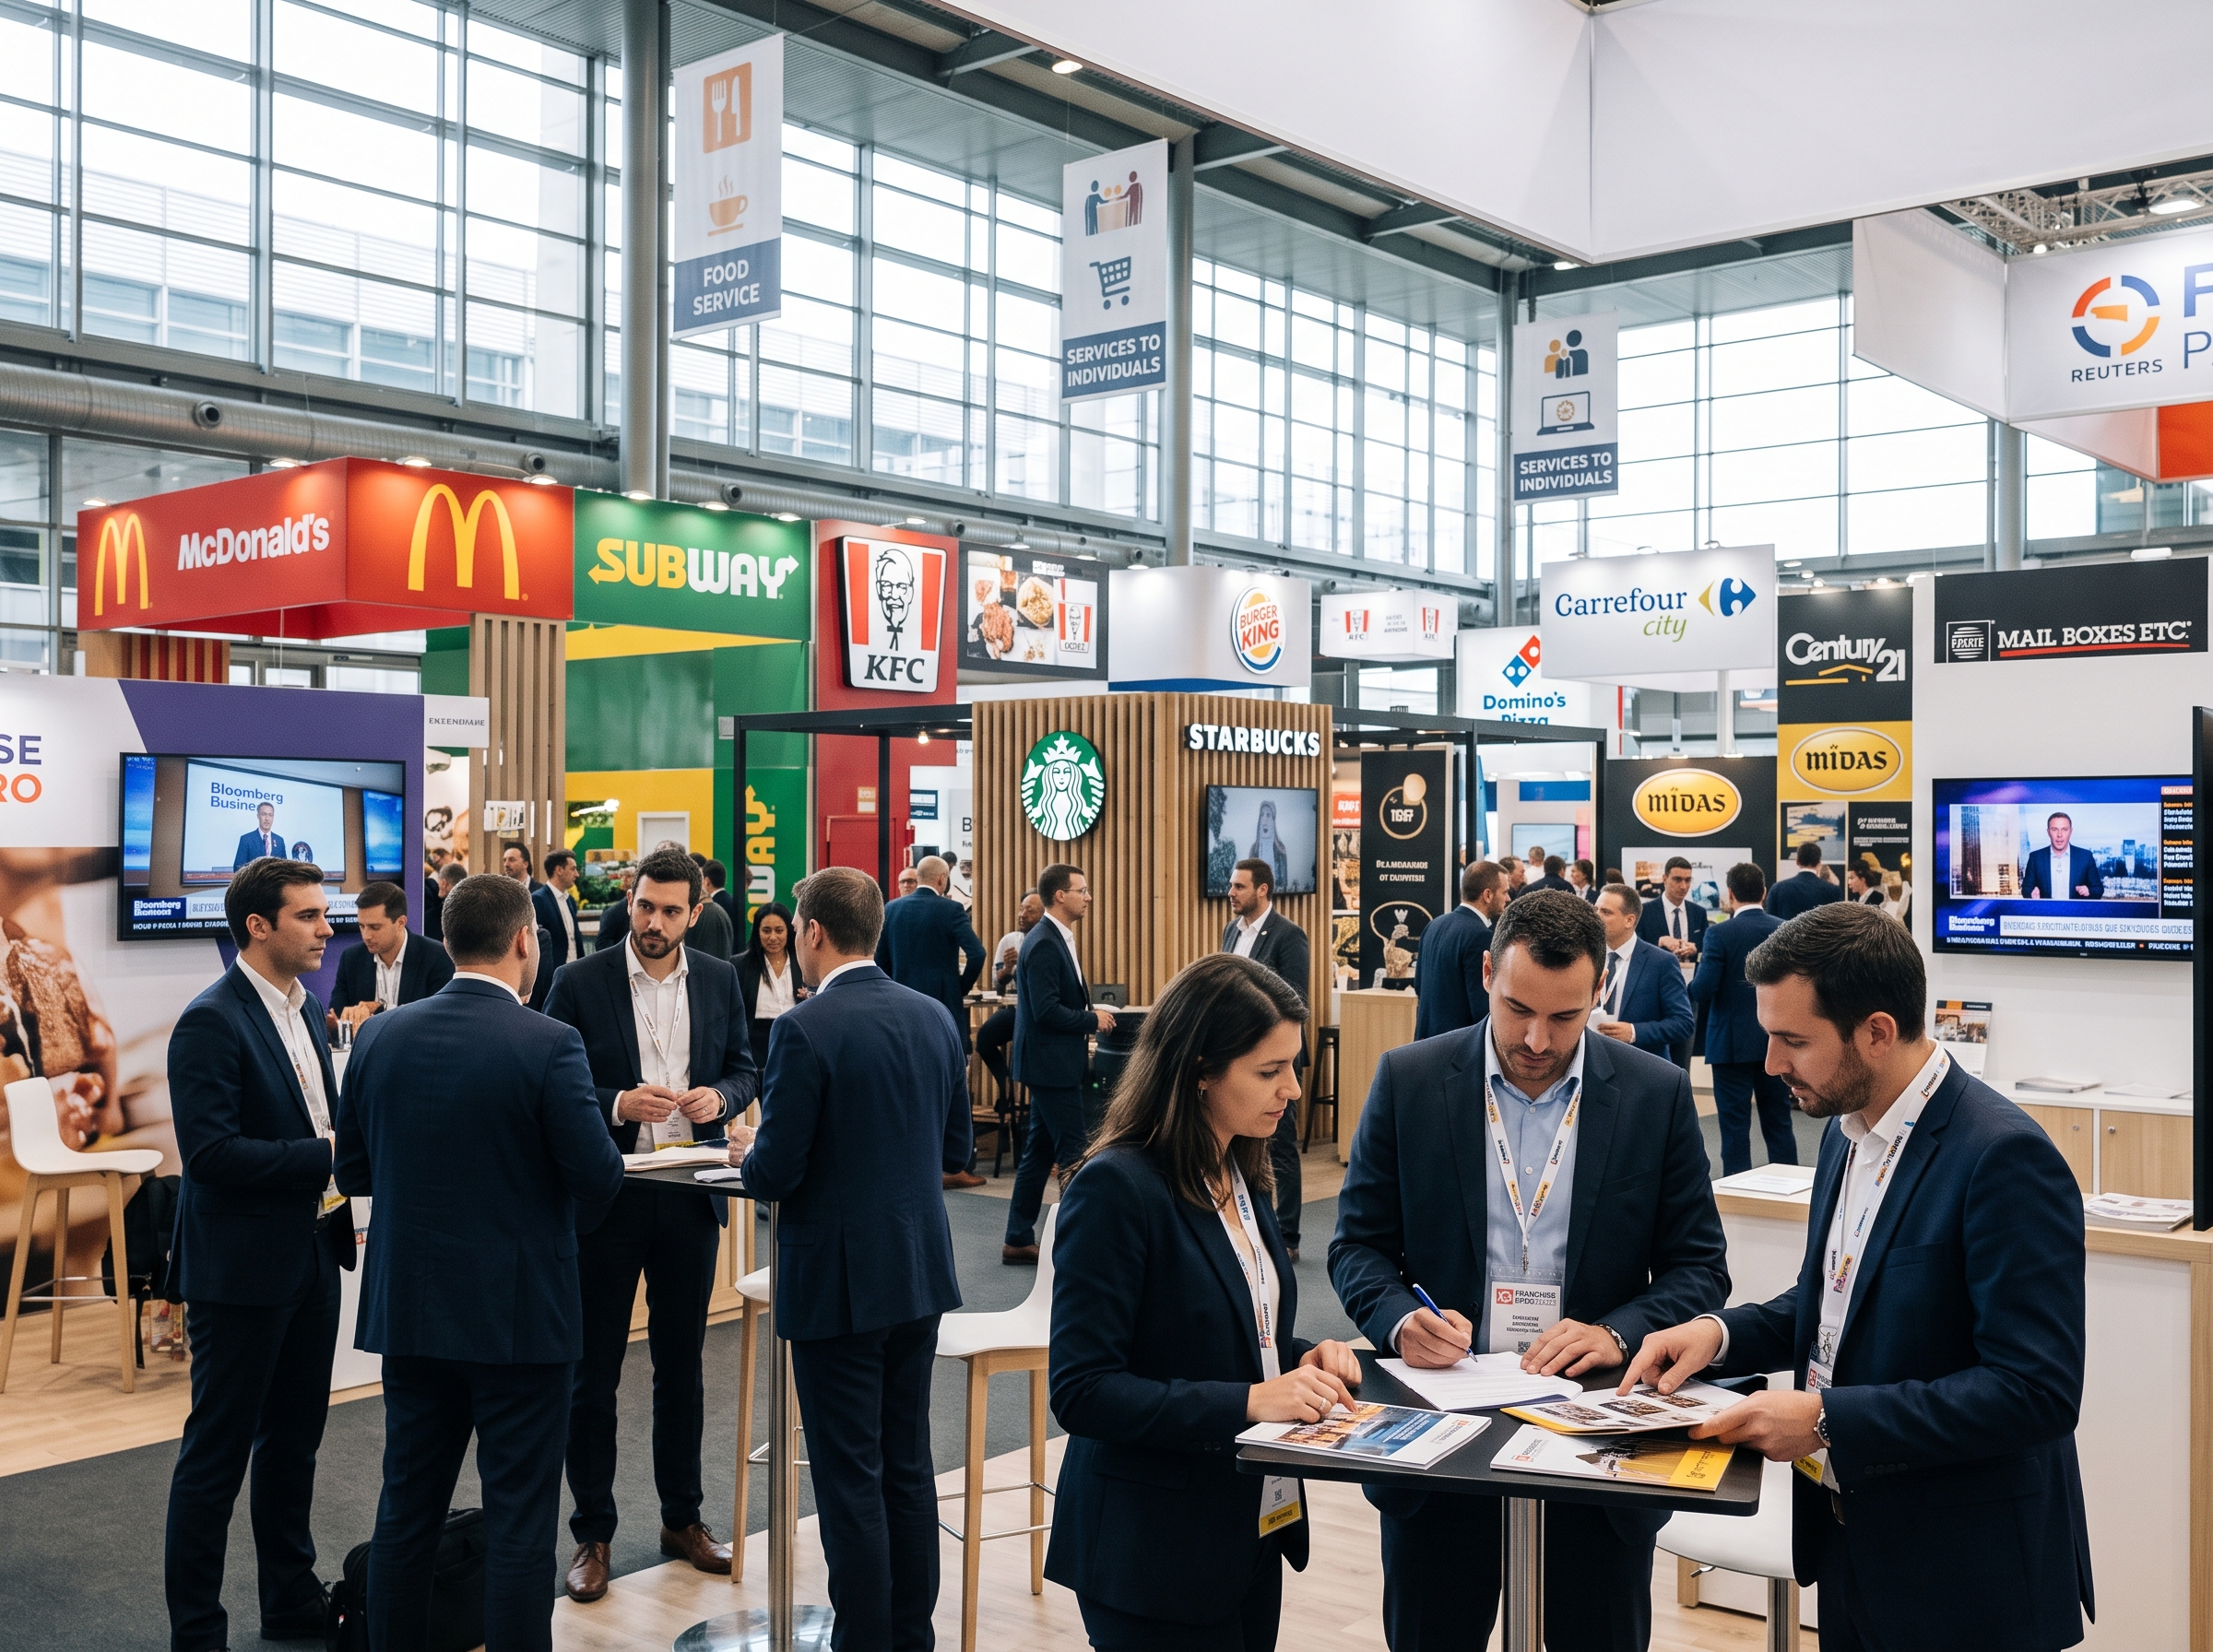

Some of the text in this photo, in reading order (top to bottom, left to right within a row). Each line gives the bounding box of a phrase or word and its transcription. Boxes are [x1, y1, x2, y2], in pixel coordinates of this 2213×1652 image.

[704, 259, 750, 288] FOOD
[692, 283, 761, 317] SERVICE
[1067, 334, 1161, 366] SERVICES TO
[1067, 356, 1162, 388] INDIVIDUALS
[2071, 359, 2163, 384] REUTERS
[1520, 452, 1613, 475] SERVICES TO
[1520, 469, 1613, 492] INDIVIDUALS
[177, 513, 330, 572] McDonald's
[587, 537, 799, 600] SUBWAY
[1240, 605, 1278, 630] BURGER
[1555, 587, 1687, 619] Carrefour
[1242, 619, 1279, 651] KING
[1642, 614, 1687, 643] city
[1997, 628, 2057, 649] MAIL
[2062, 624, 2136, 645] BOXES
[864, 654, 926, 685] KFC
[1785, 632, 1906, 682] Century 21
[1483, 691, 1567, 710] Domino's
[1189, 723, 1320, 757] STARBUCKS
[210, 796, 257, 811] Busine
[211, 782, 284, 805] Bloomberg
[745, 785, 776, 925] WAY
